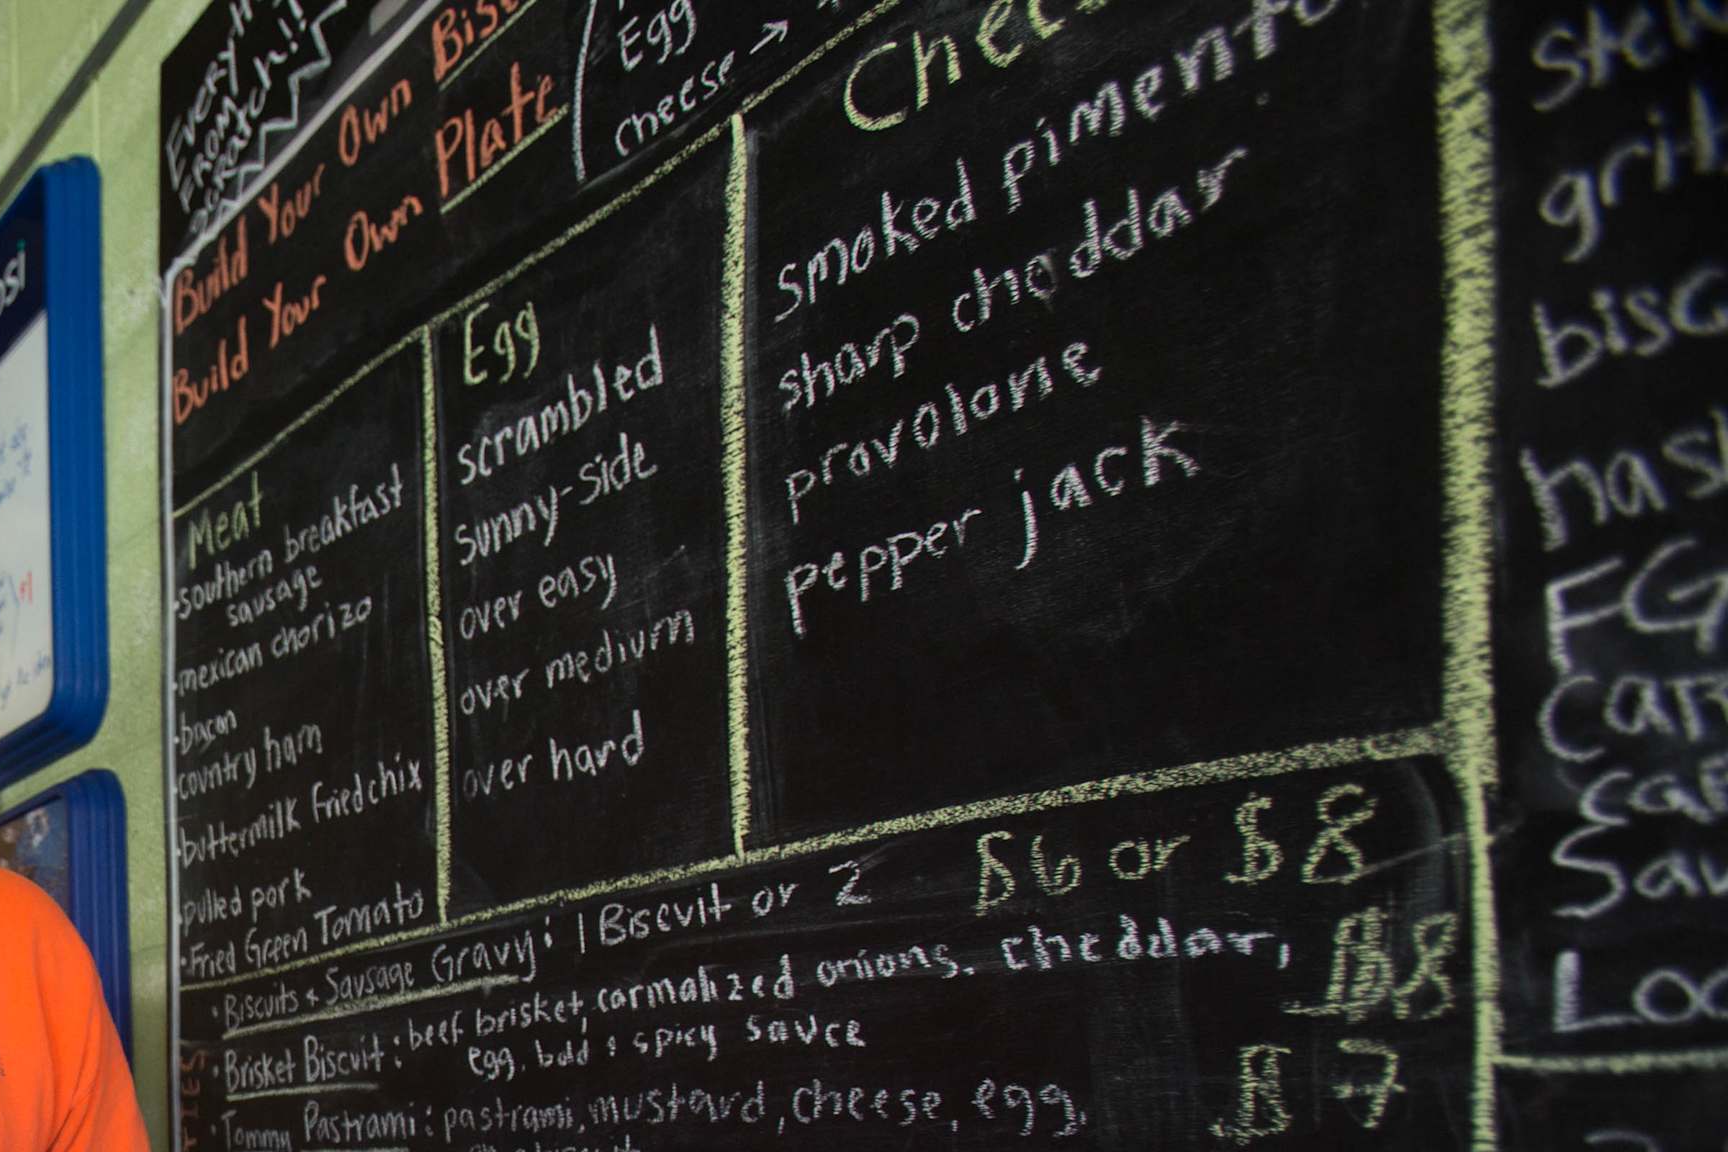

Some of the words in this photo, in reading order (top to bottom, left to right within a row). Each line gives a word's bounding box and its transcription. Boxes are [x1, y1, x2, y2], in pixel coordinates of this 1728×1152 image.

[617, 0, 696, 71] Egg
[615, 50, 735, 156] cheese
[174, 214, 249, 335] Build
[258, 163, 325, 243] Your
[338, 79, 412, 166] Own
[1538, 80, 1728, 262] grit
[173, 314, 249, 425] Build
[262, 274, 328, 349] Your
[344, 195, 424, 271] Own
[435, 60, 558, 197] Plate
[775, 156, 977, 324] smoked
[463, 300, 541, 386] Egg
[1534, 266, 1728, 388] bisc
[456, 321, 665, 486] scrambled
[186, 469, 263, 571] Meat
[282, 461, 404, 565] breakfast
[783, 508, 983, 641] pepper
[1015, 413, 1203, 572] jack
[1520, 402, 1728, 552] has
[177, 641, 265, 698] mexican
[271, 595, 374, 659] chorizo
[225, 564, 323, 628] sausage
[458, 589, 524, 642] over
[537, 551, 620, 612] easy
[458, 667, 531, 717] over
[544, 606, 696, 690] medium
[177, 747, 258, 801] country
[263, 723, 324, 773] ham
[179, 708, 239, 755] bacon
[461, 751, 534, 799] over
[548, 708, 646, 784] hard
[179, 797, 303, 869] buttermilk
[368, 751, 424, 806] chix
[183, 883, 242, 937] pulled
[250, 866, 313, 923] pork
[188, 940, 237, 979] Fried
[244, 925, 309, 969] Green
[312, 880, 426, 947] Tomato
[224, 982, 300, 1033] Biscuits
[325, 961, 416, 1006] Sausage
[598, 881, 733, 947] Biscuit
[751, 881, 800, 917] or
[827, 858, 874, 908] 2
[1108, 833, 1191, 882] or
[224, 1048, 297, 1094] Brisket
[407, 1009, 465, 1051] beef
[632, 1022, 719, 1062] spicy
[745, 1014, 866, 1048] sauce
